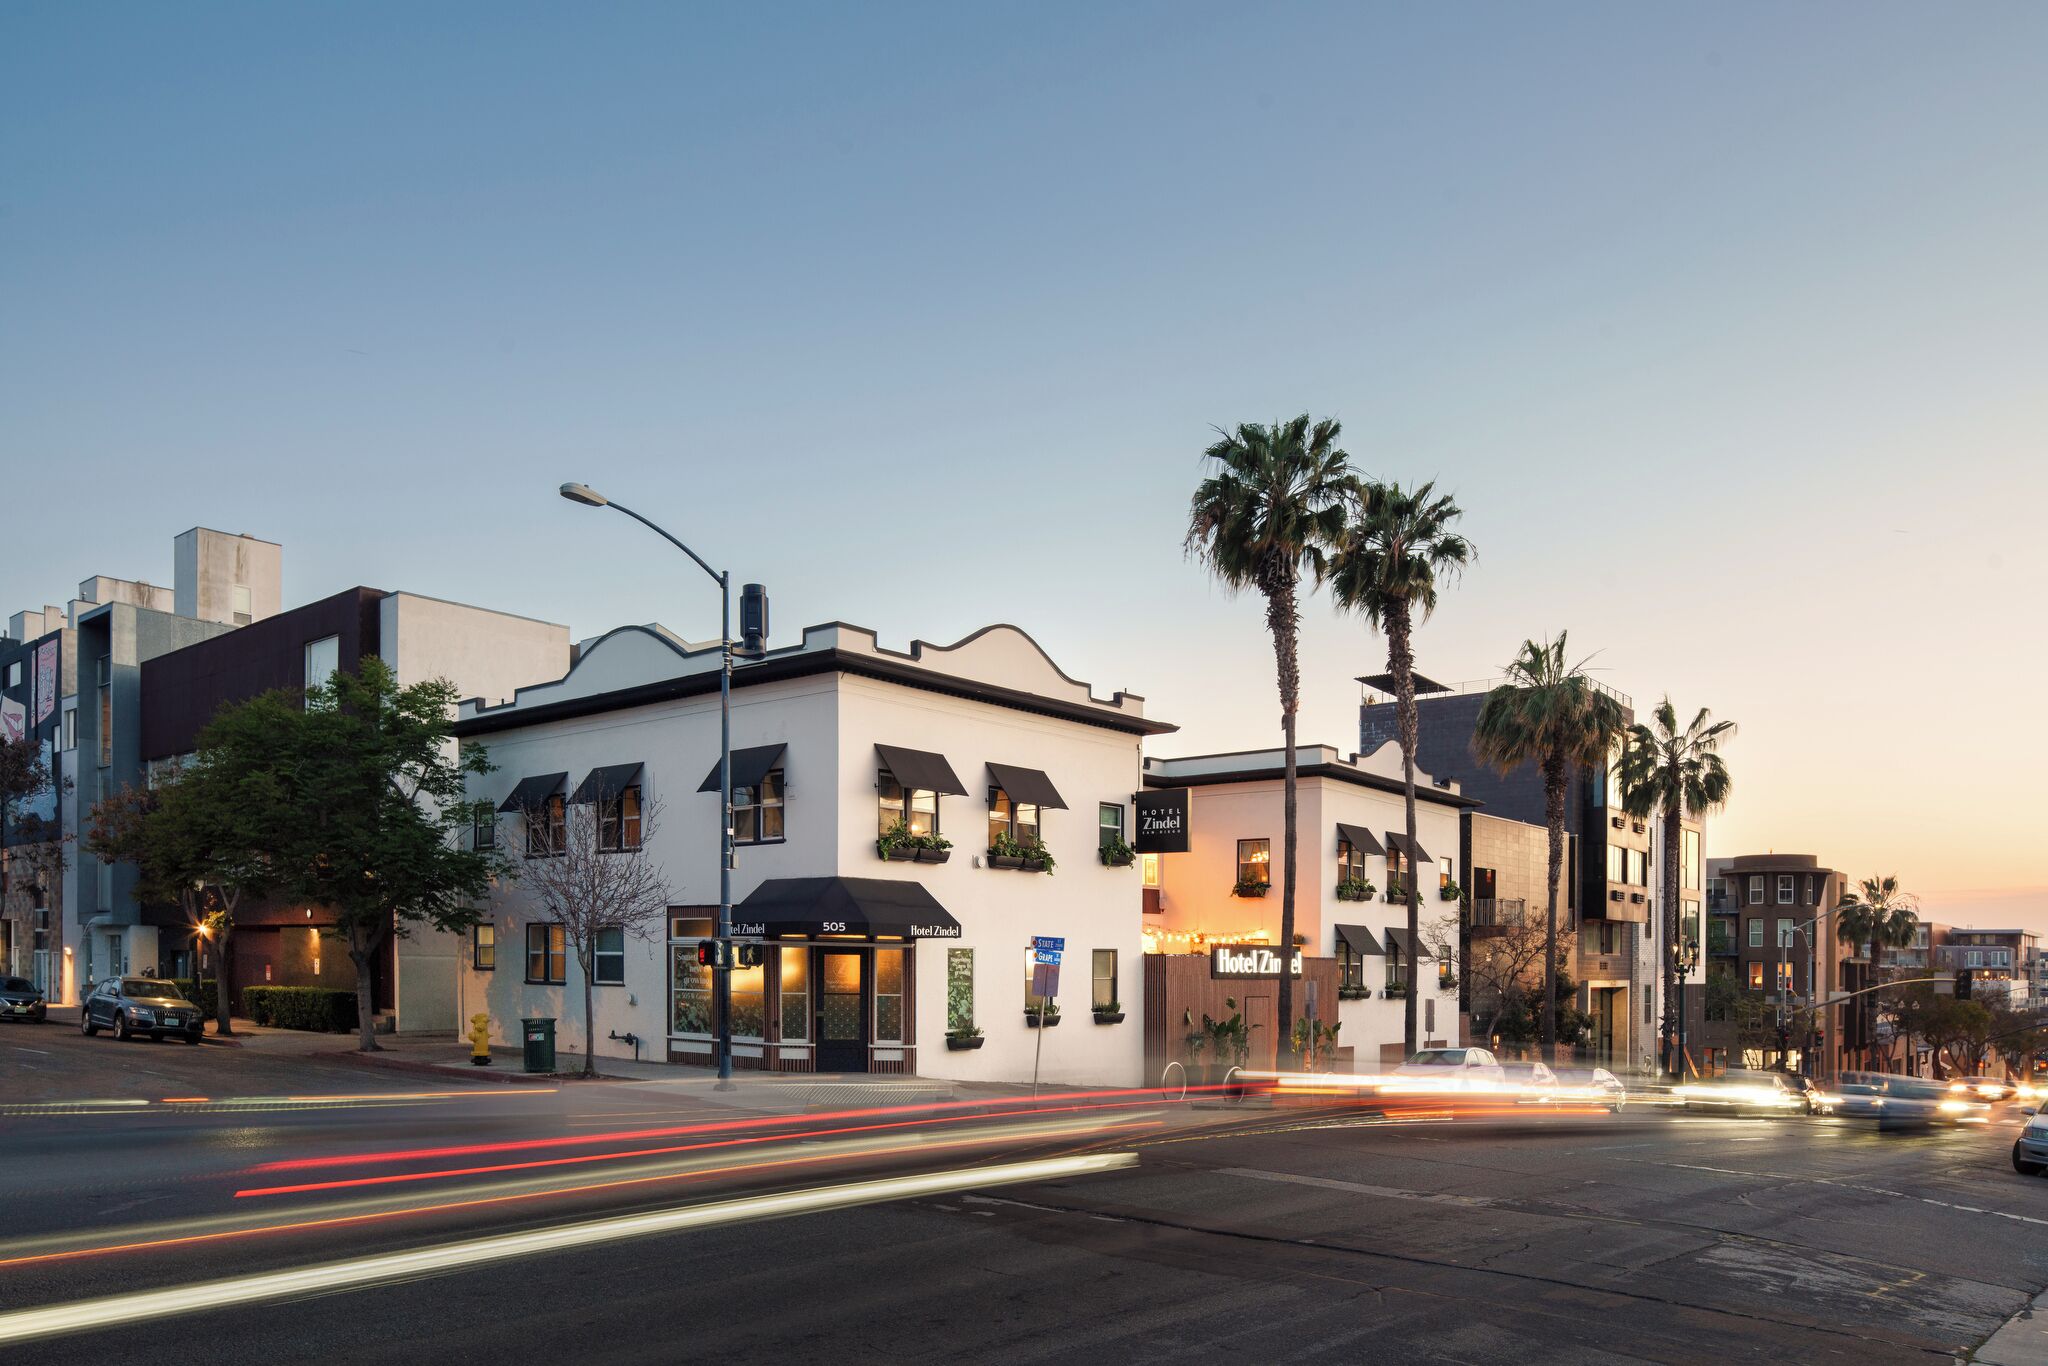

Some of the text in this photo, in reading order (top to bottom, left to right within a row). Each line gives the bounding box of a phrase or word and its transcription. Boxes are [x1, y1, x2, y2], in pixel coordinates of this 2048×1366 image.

[1142, 808, 1181, 816] HOTEL
[1143, 815, 1180, 830] Zindel
[730, 923, 765, 934] tel Zindel
[823, 922, 846, 931] 505
[911, 925, 959, 936] Hotel Zindel
[1216, 948, 1303, 974] Hotel Zinel
